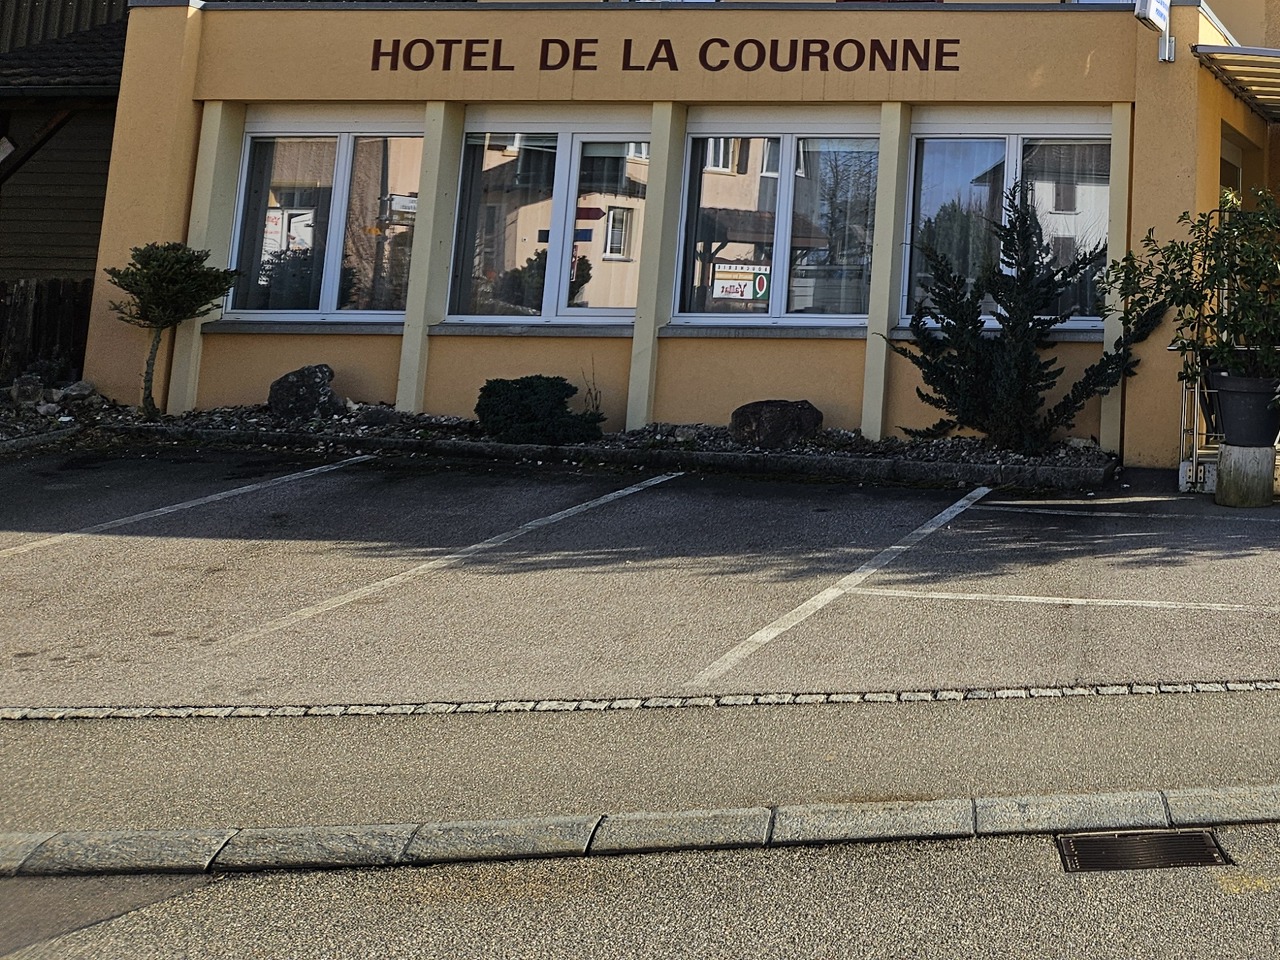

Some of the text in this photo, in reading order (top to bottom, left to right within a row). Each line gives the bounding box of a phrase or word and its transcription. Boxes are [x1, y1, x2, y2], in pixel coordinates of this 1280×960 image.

[370, 37, 961, 72] HOTEL DE LA COURONNE
